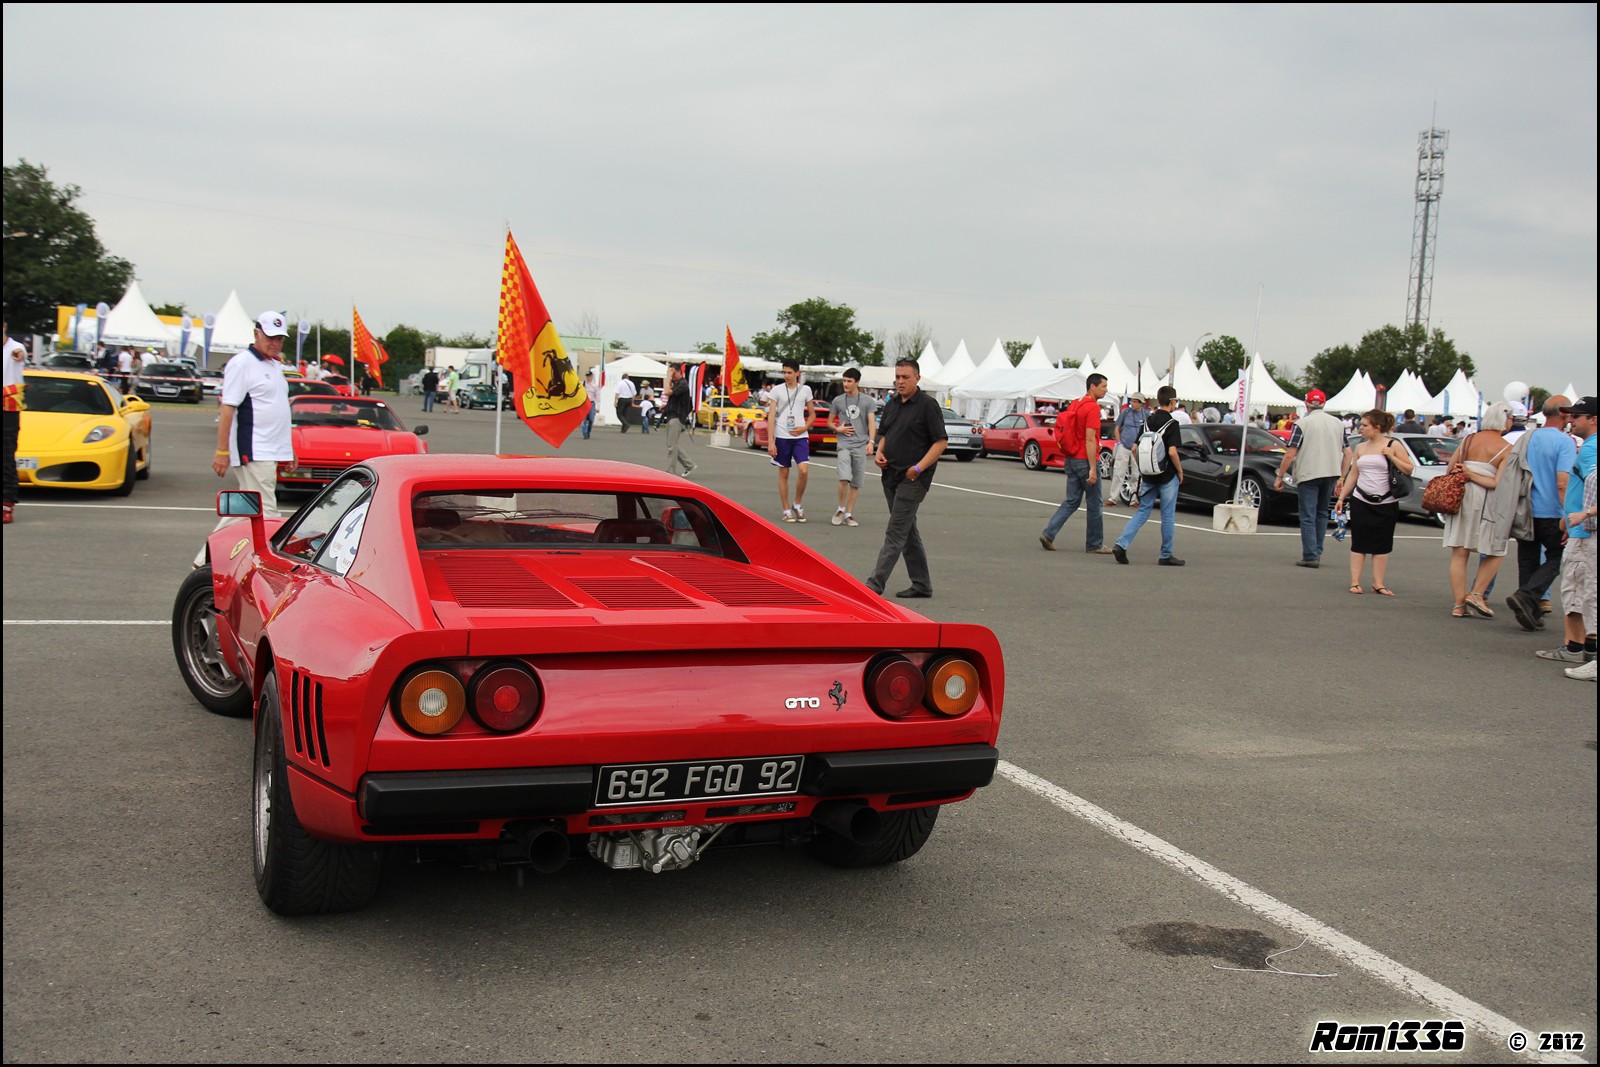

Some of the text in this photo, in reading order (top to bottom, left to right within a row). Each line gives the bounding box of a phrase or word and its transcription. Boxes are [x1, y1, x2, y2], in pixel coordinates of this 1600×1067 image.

[784, 696, 820, 709] GTO
[607, 760, 797, 800] 692 FGQ 92
